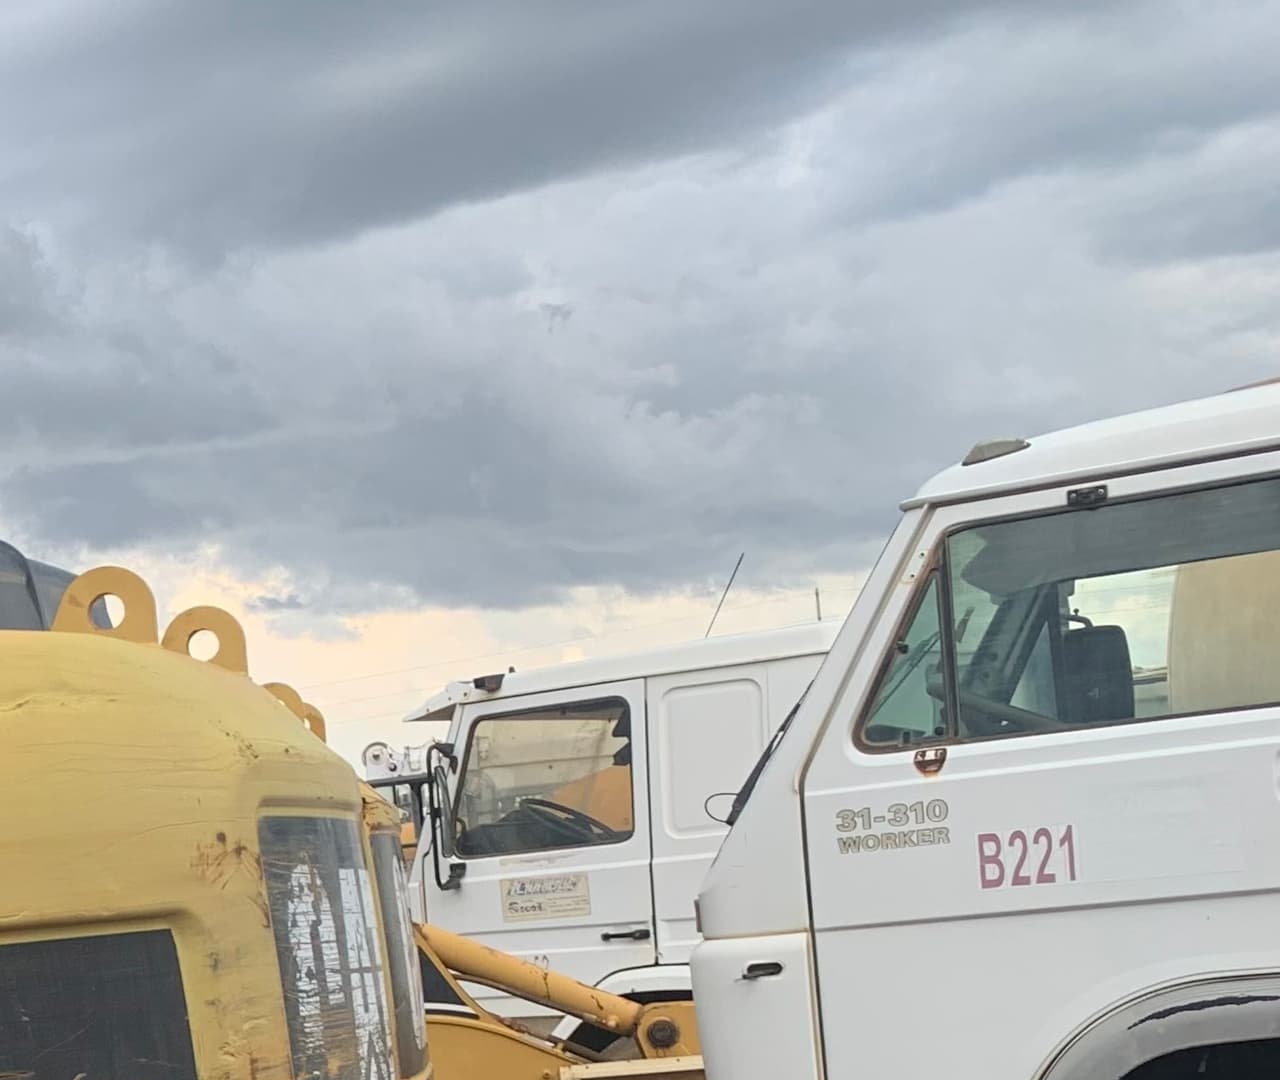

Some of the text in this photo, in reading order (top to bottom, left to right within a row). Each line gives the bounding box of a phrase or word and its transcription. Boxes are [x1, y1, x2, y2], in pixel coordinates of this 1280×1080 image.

[836, 798, 949, 833] 31-310
[837, 826, 951, 855] WORKER
[977, 824, 1078, 890] B221
